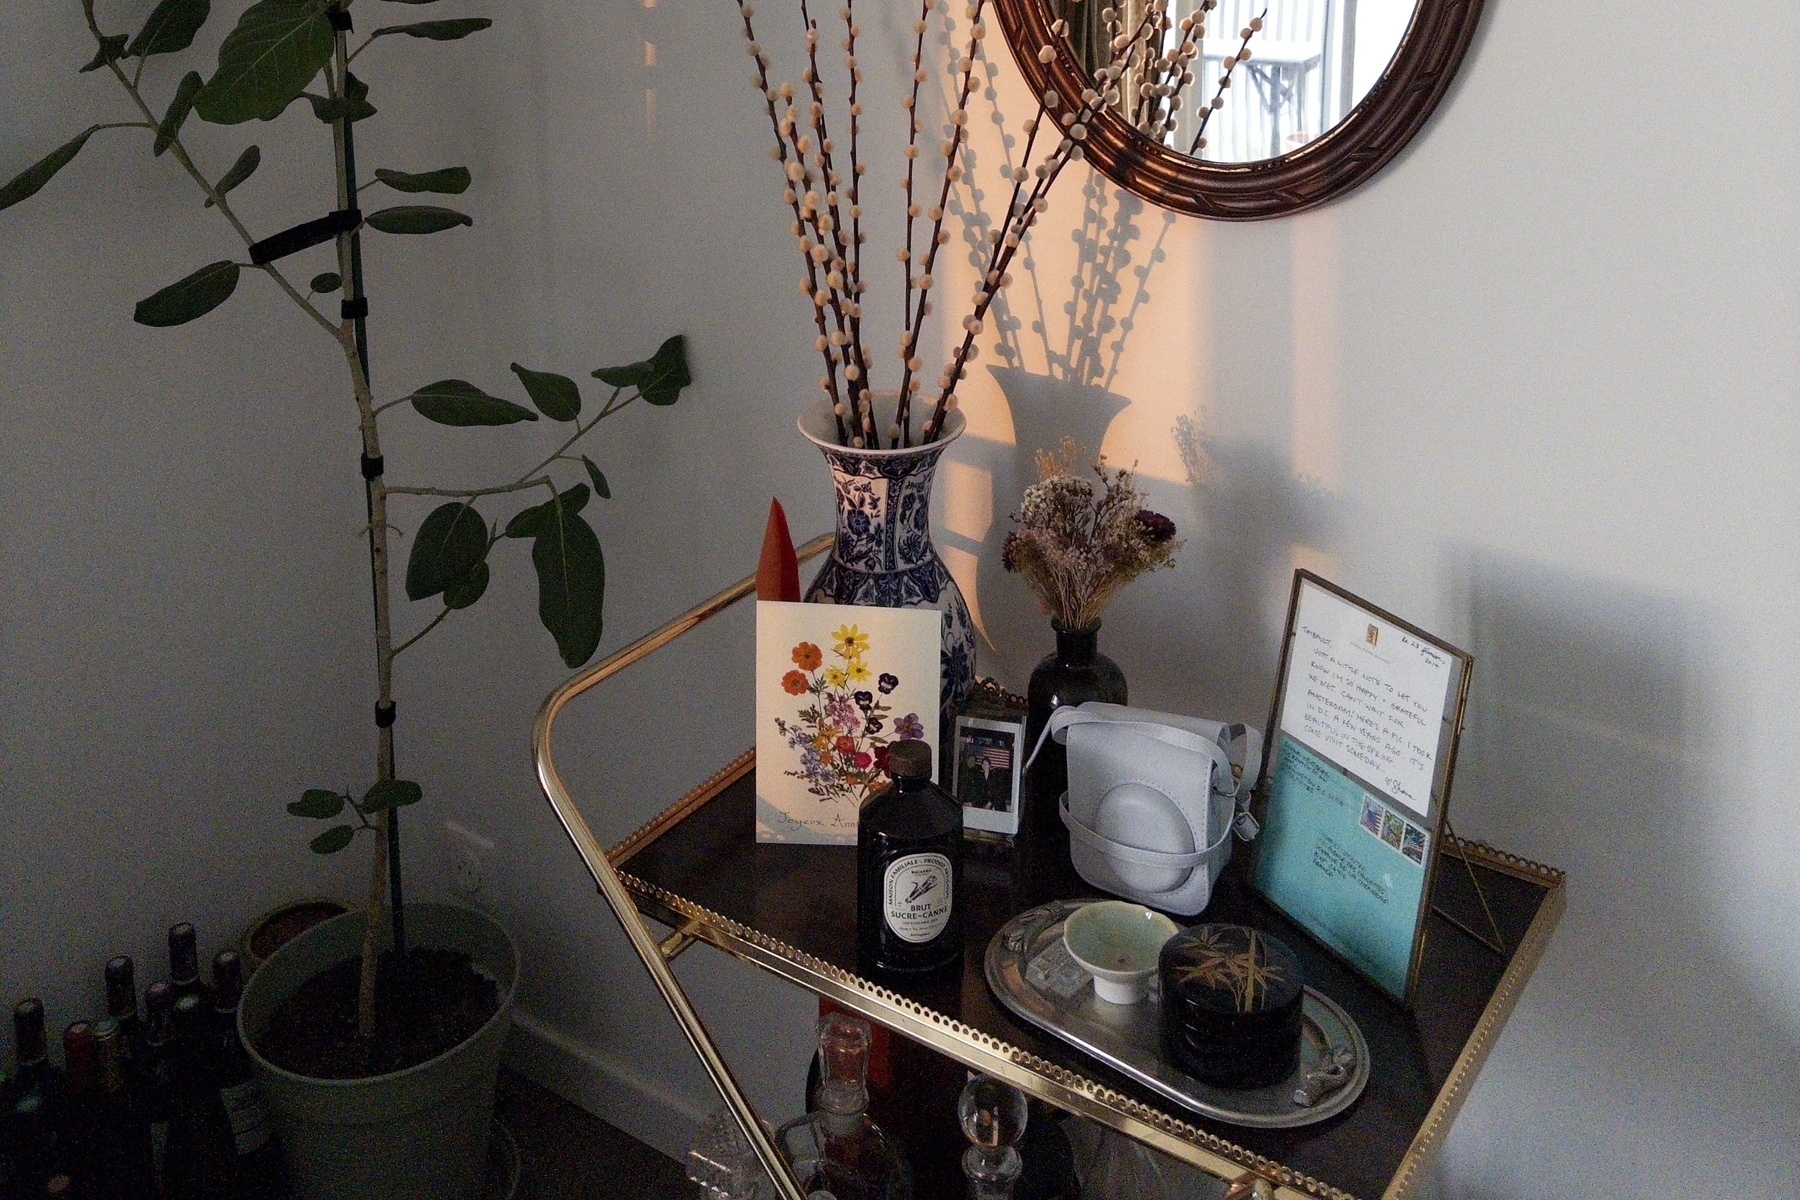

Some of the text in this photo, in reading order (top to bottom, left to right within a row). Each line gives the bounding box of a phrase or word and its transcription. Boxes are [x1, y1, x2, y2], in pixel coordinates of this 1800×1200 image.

[1310, 661, 1329, 674] KNOW
[1356, 685, 1377, 701] HAPPY
[1390, 702, 1425, 726] GRATEFUL
[1337, 660, 1358, 675] LITTLE
[1362, 673, 1380, 685] NOTE
[1397, 691, 1410, 701] LET
[1413, 701, 1427, 712] YOU
[1365, 705, 1384, 717] WAIT
[1388, 715, 1404, 728] FOR
[1304, 724, 1320, 737] COME
[1325, 735, 1343, 747] VISIT
[1342, 719, 1355, 730] FEW
[1359, 727, 1381, 743] YEARS
[1351, 736, 1365, 750] THE
[1391, 732, 1402, 743] PIC
[1413, 745, 1431, 760] TOOK
[778, 811, 824, 831] Joyeux
[891, 858, 918, 879] FAMILIALE
[924, 857, 946, 868] PRODUIT
[890, 905, 948, 920] SUCRE-CANNE
[910, 903, 932, 912] BRUT
